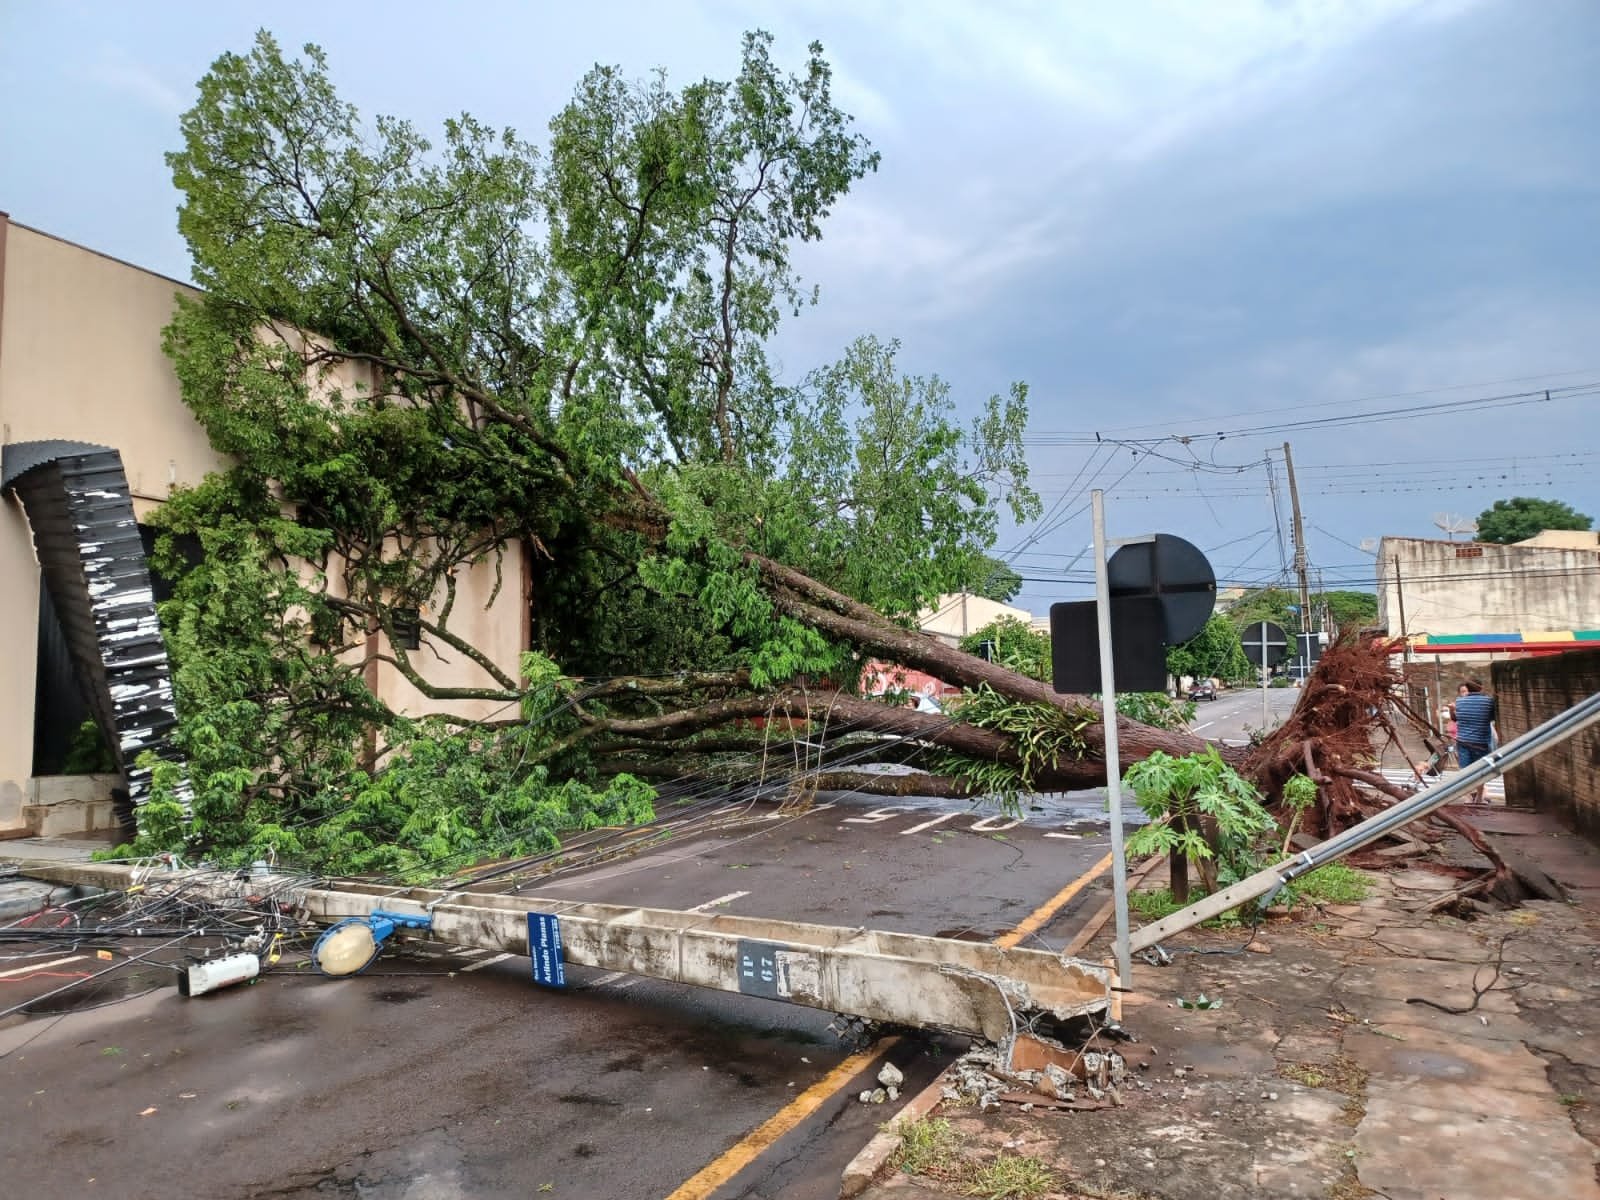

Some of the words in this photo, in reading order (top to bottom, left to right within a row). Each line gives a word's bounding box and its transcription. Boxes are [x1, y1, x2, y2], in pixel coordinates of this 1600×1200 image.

[542, 949, 552, 983] Arlindo
[743, 955, 754, 977] IP
[761, 957, 773, 982] 67
